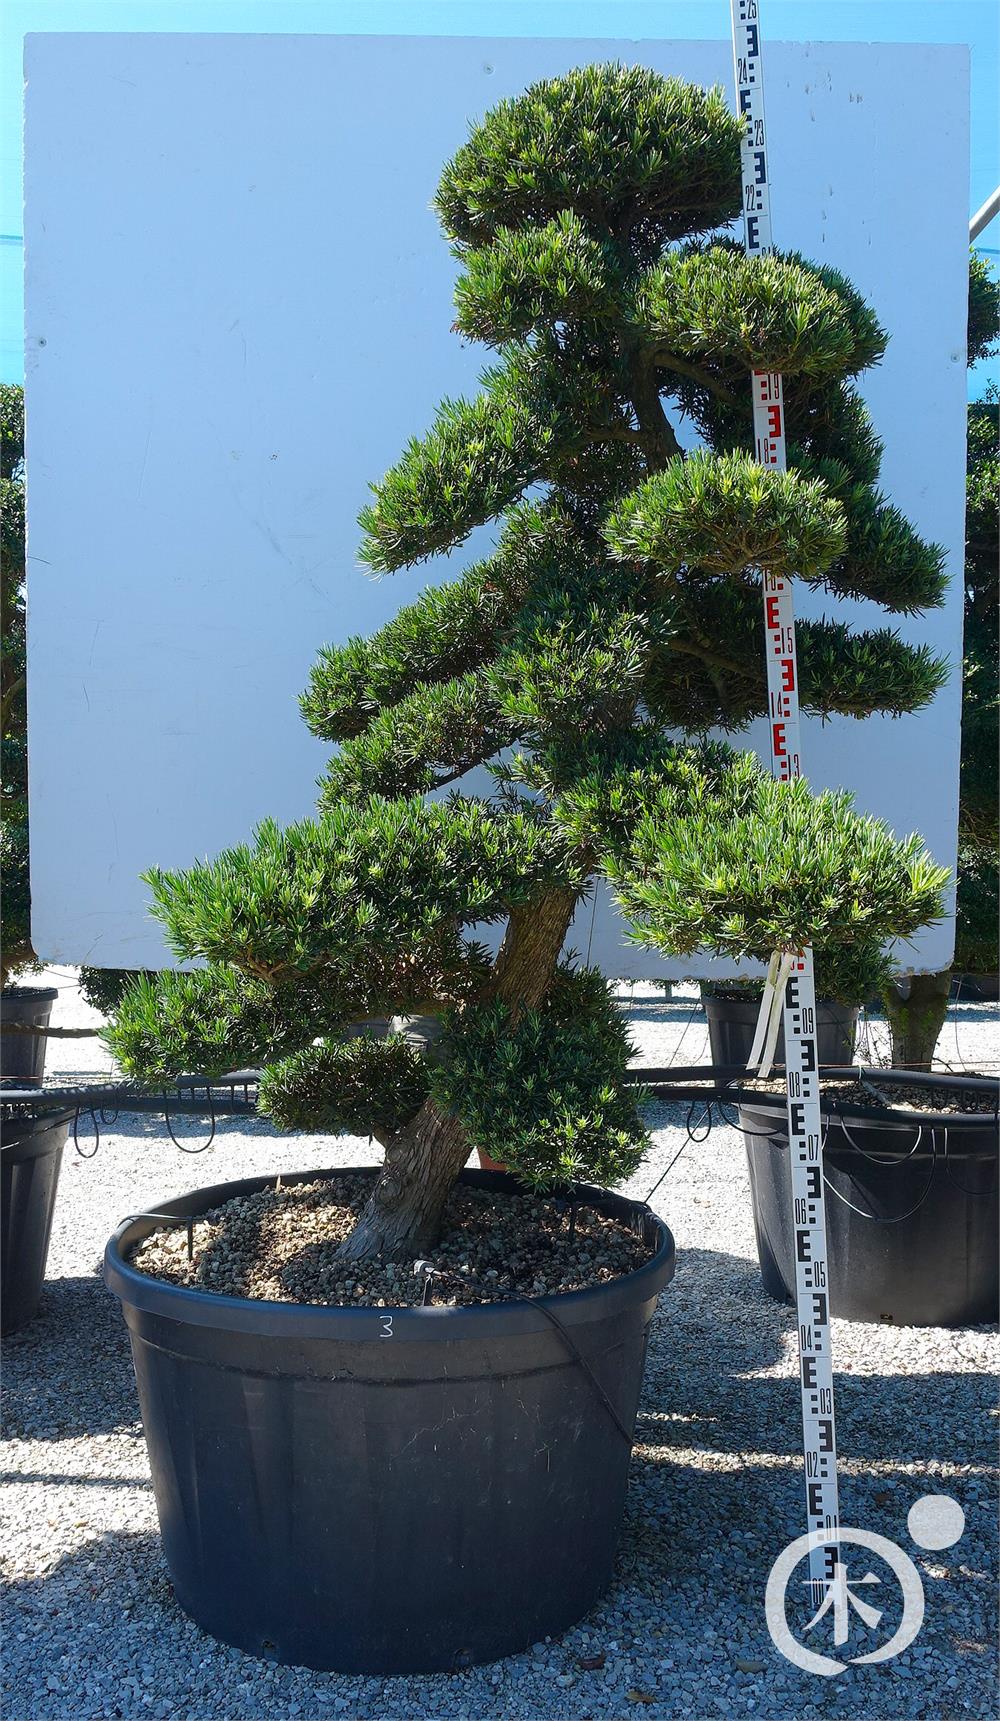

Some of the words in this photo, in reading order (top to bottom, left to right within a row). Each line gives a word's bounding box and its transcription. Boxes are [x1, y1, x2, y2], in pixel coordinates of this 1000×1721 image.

[747, 0, 757, 19] 25
[738, 58, 748, 84] 24
[754, 119, 764, 146] 23
[745, 185, 755, 211] 22
[768, 374, 779, 400] 19
[757, 438, 769, 465] 18
[781, 627, 793, 654] 15
[771, 691, 782, 718] 14
[788, 754, 800, 780] 13
[802, 1007, 814, 1034] 09
[789, 1072, 800, 1098] 08
[808, 1134, 819, 1161] 07
[795, 1198, 807, 1225] 06
[814, 1261, 826, 1287] 05
[379, 1315, 394, 1338] 3
[801, 1325, 812, 1351] 04
[820, 1388, 832, 1414] 03
[807, 1451, 818, 1478] 02
